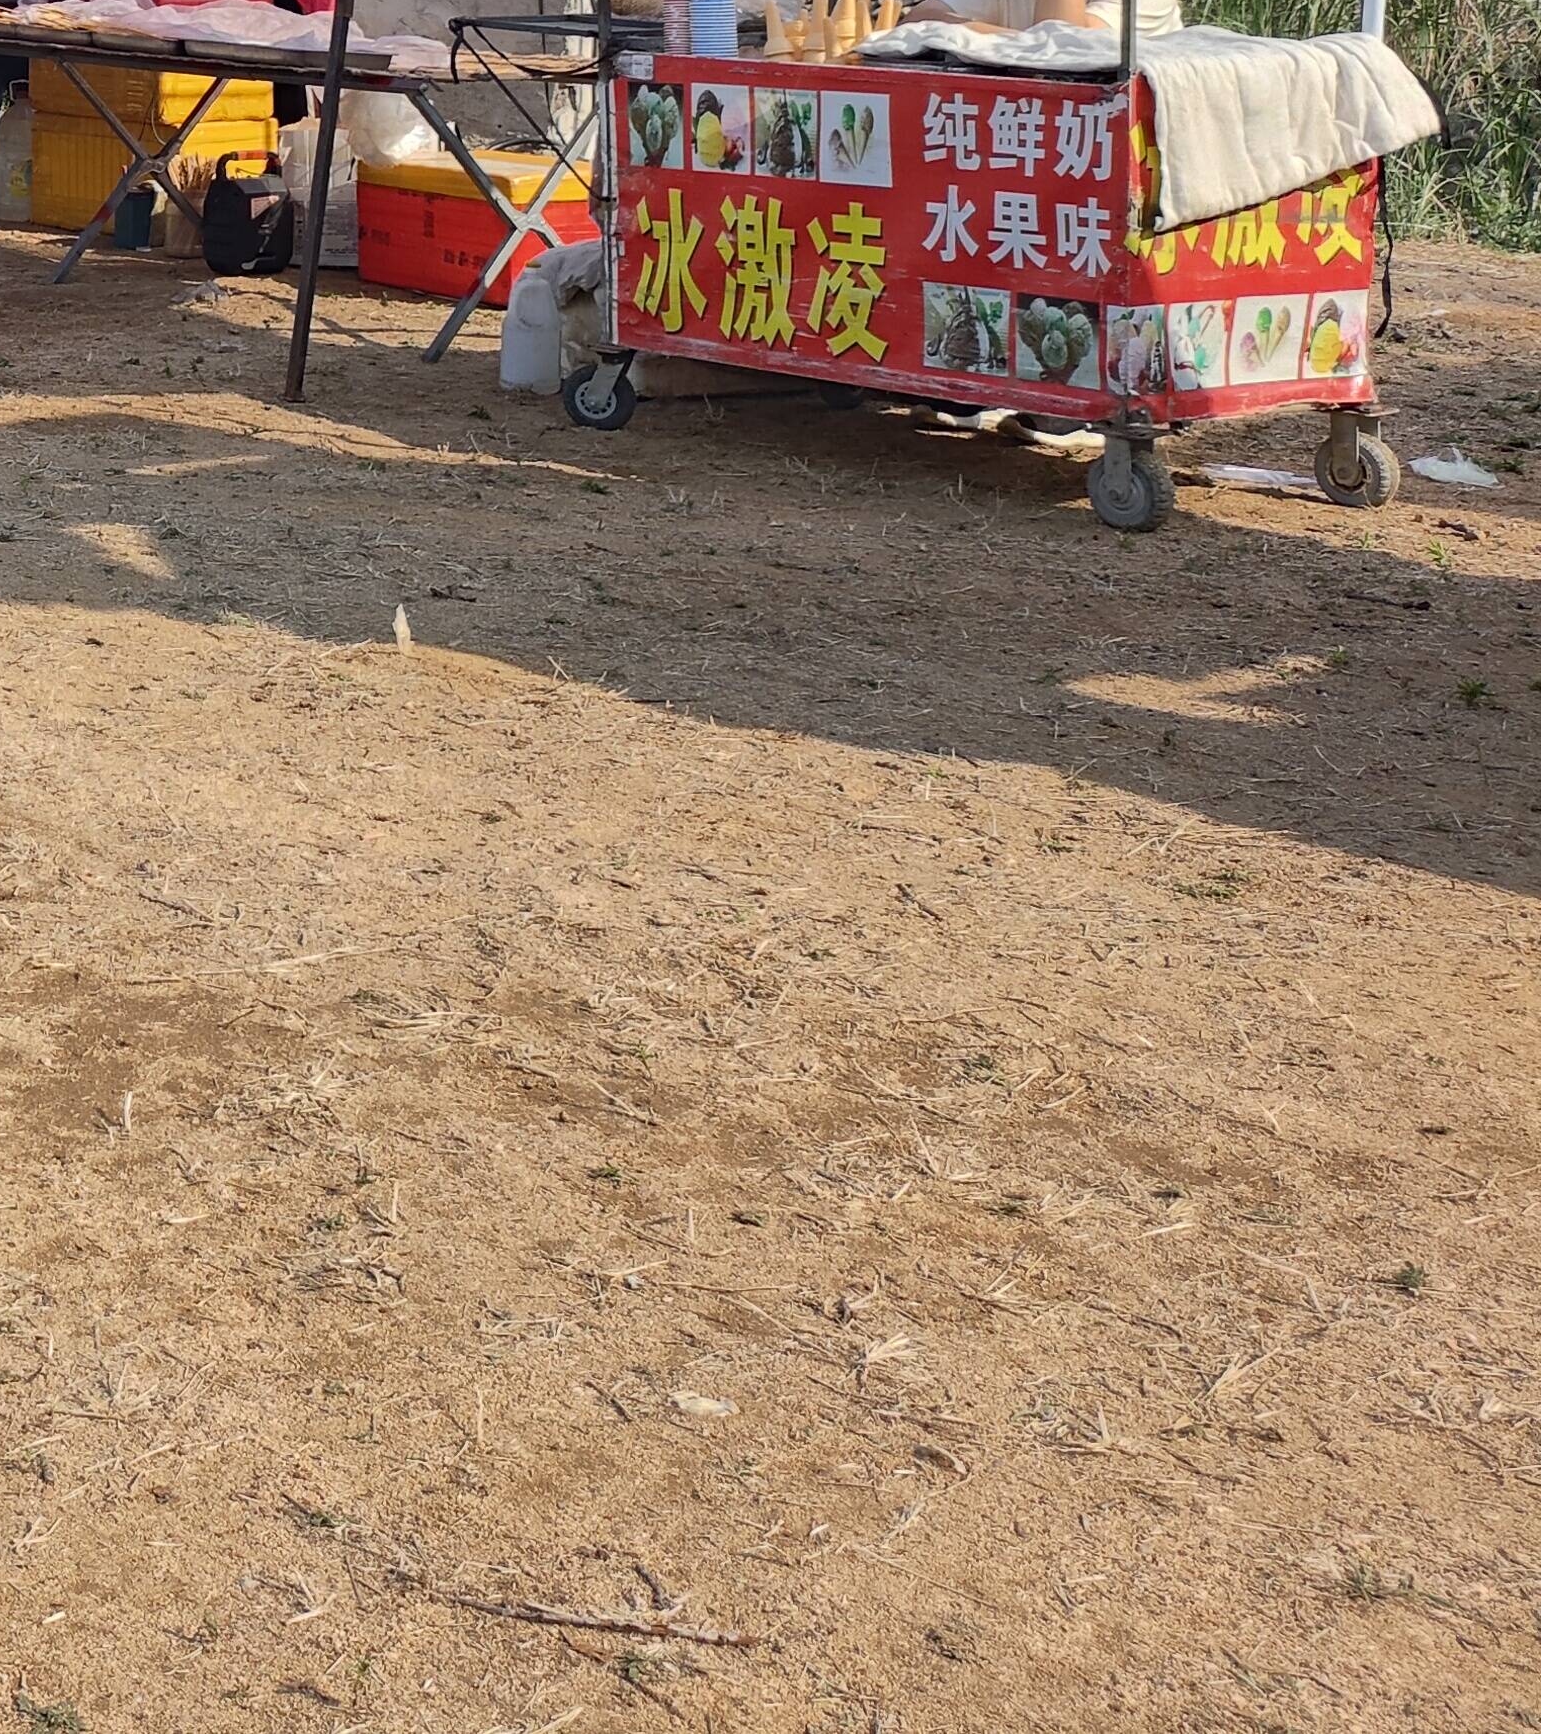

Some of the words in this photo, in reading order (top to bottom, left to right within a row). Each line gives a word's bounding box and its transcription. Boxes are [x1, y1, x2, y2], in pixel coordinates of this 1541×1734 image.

[921, 92, 1115, 182] 纯鲜奶
[633, 187, 888, 364] 冰激凌
[923, 184, 1113, 278] 水果味
